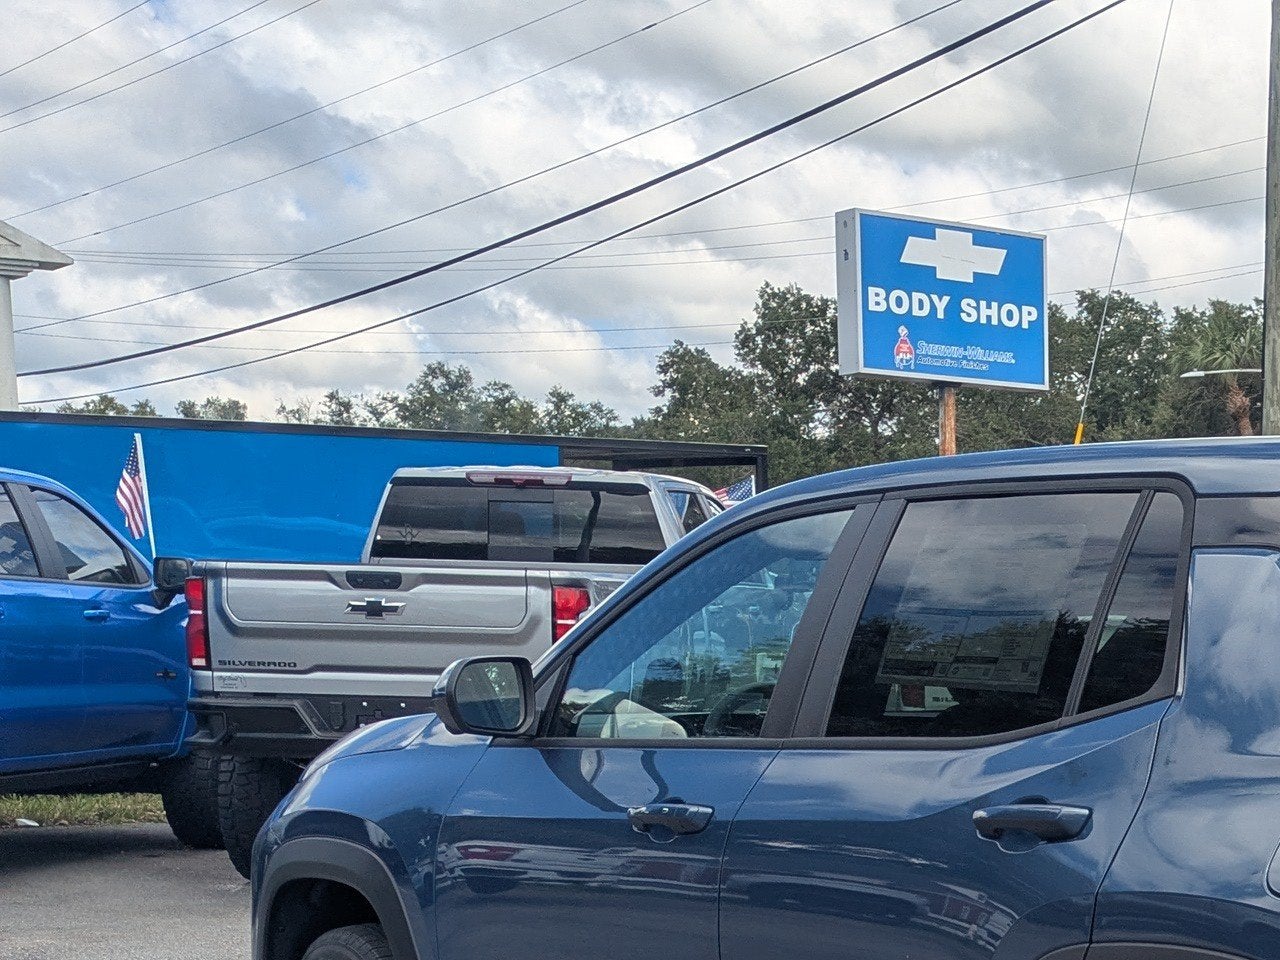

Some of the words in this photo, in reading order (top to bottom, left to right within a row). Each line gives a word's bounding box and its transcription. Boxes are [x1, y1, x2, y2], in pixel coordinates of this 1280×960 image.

[868, 286, 950, 319] BODY
[960, 298, 1038, 329] SHOP
[217, 659, 298, 668] SILVERADO
